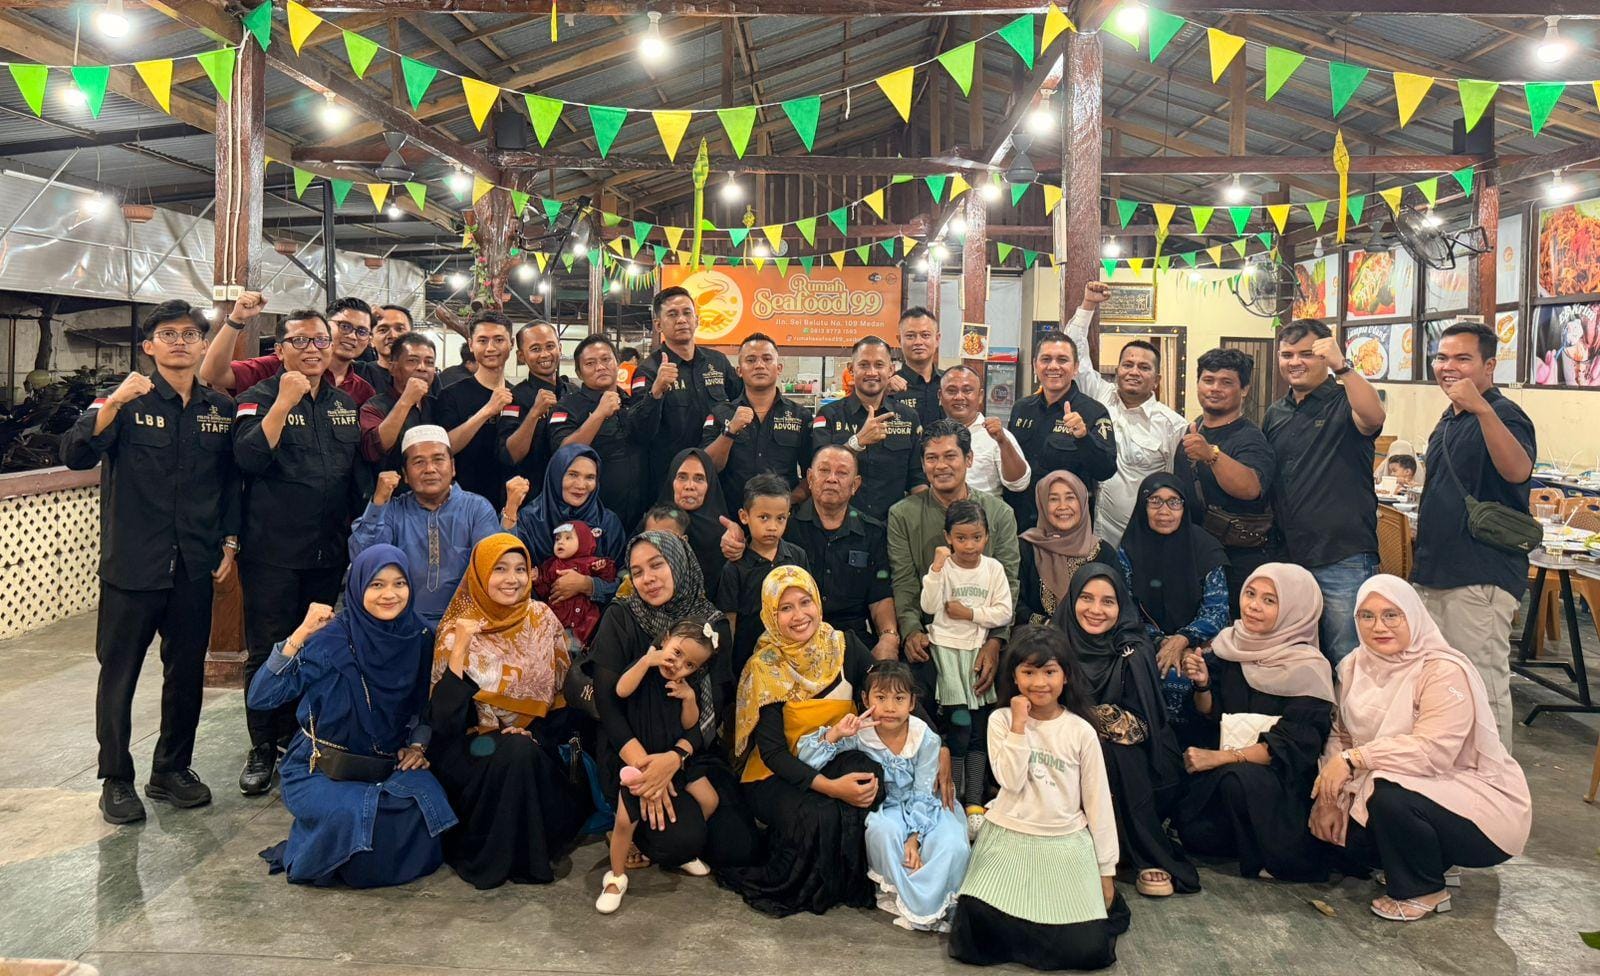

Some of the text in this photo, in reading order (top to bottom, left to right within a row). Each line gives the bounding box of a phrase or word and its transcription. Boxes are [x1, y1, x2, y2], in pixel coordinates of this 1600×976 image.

[790, 275, 844, 296] Rumah
[753, 290, 881, 318] Seafood 99
[860, 320, 886, 328] Medan
[135, 412, 165, 428] LBB
[283, 413, 306, 426] OSE
[331, 416, 356, 426] STAFF
[200, 422, 230, 434] STAFF
